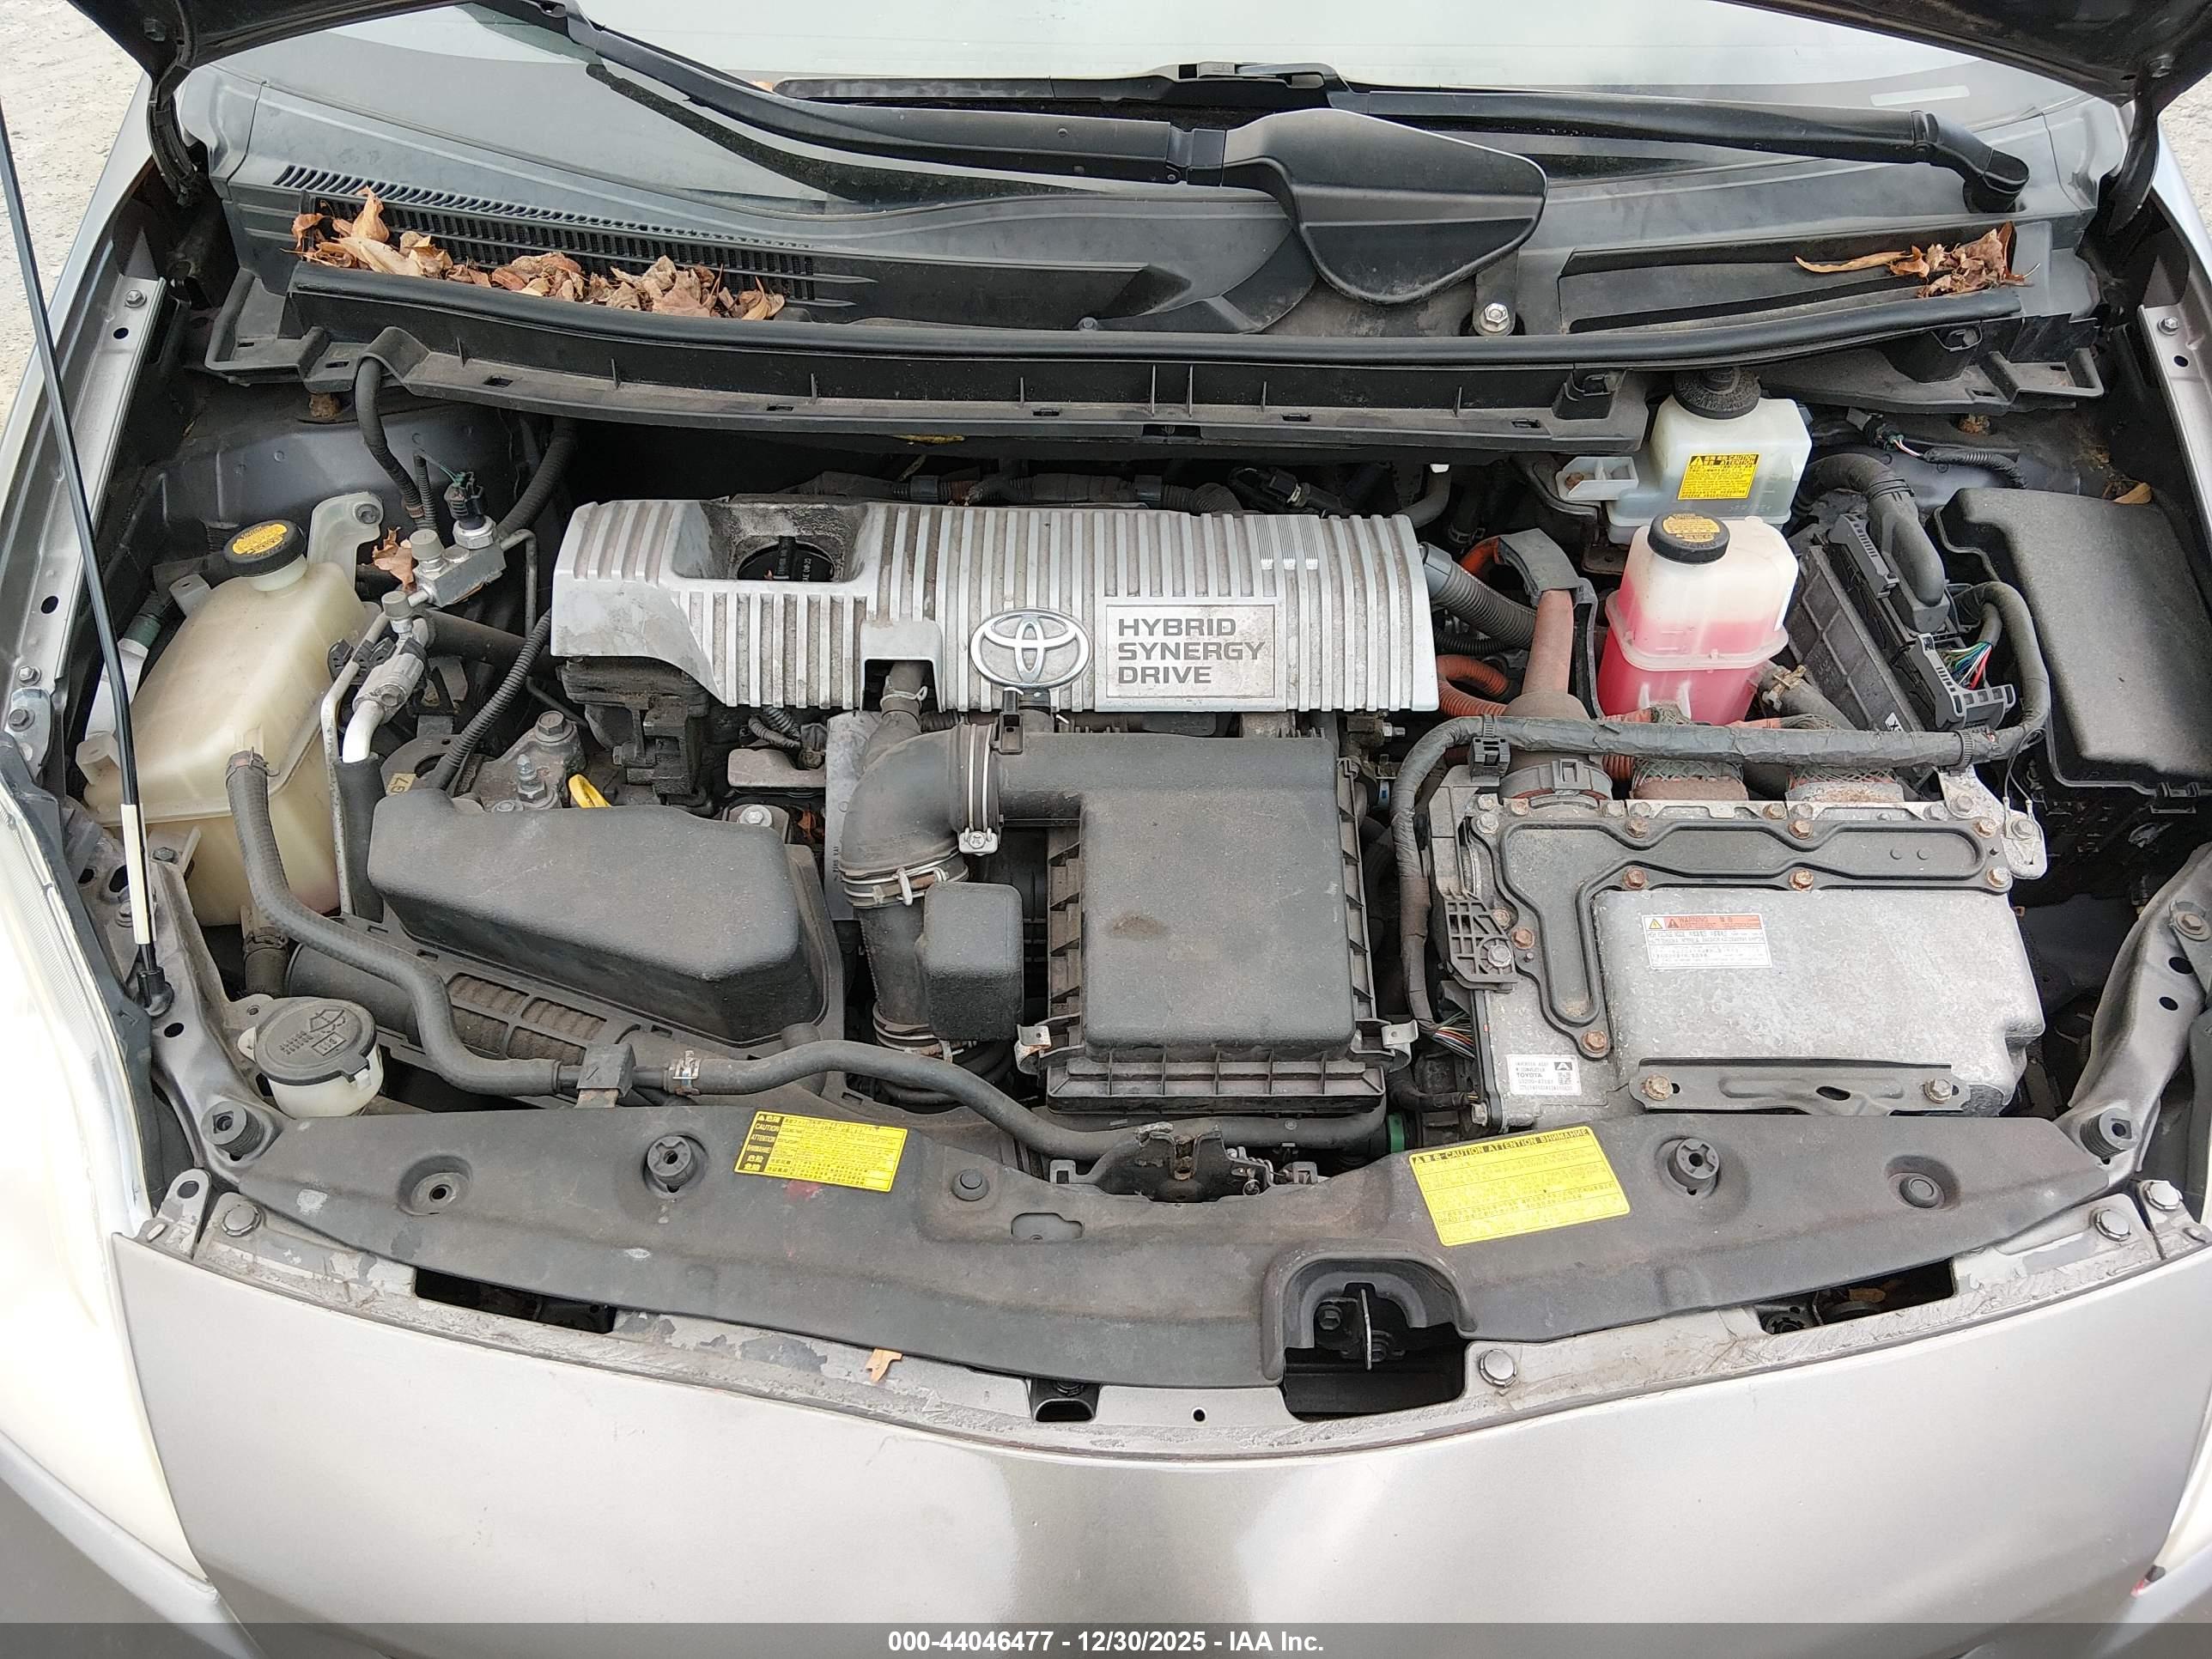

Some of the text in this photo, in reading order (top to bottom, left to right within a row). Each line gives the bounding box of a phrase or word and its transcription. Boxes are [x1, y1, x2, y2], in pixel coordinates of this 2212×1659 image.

[1118, 617, 1237, 636] HYBRID
[1118, 641, 1266, 660] SYNERGY
[1118, 666, 1212, 684] DRIVE
[755, 1122, 781, 1132] CAUTION
[750, 1133, 776, 1143] ATTENTION
[1540, 1129, 1589, 1144] ВНИМАНИЕ
[1445, 1146, 1485, 1159] CAUTION
[1487, 1138, 1538, 1152] ATTENTION
